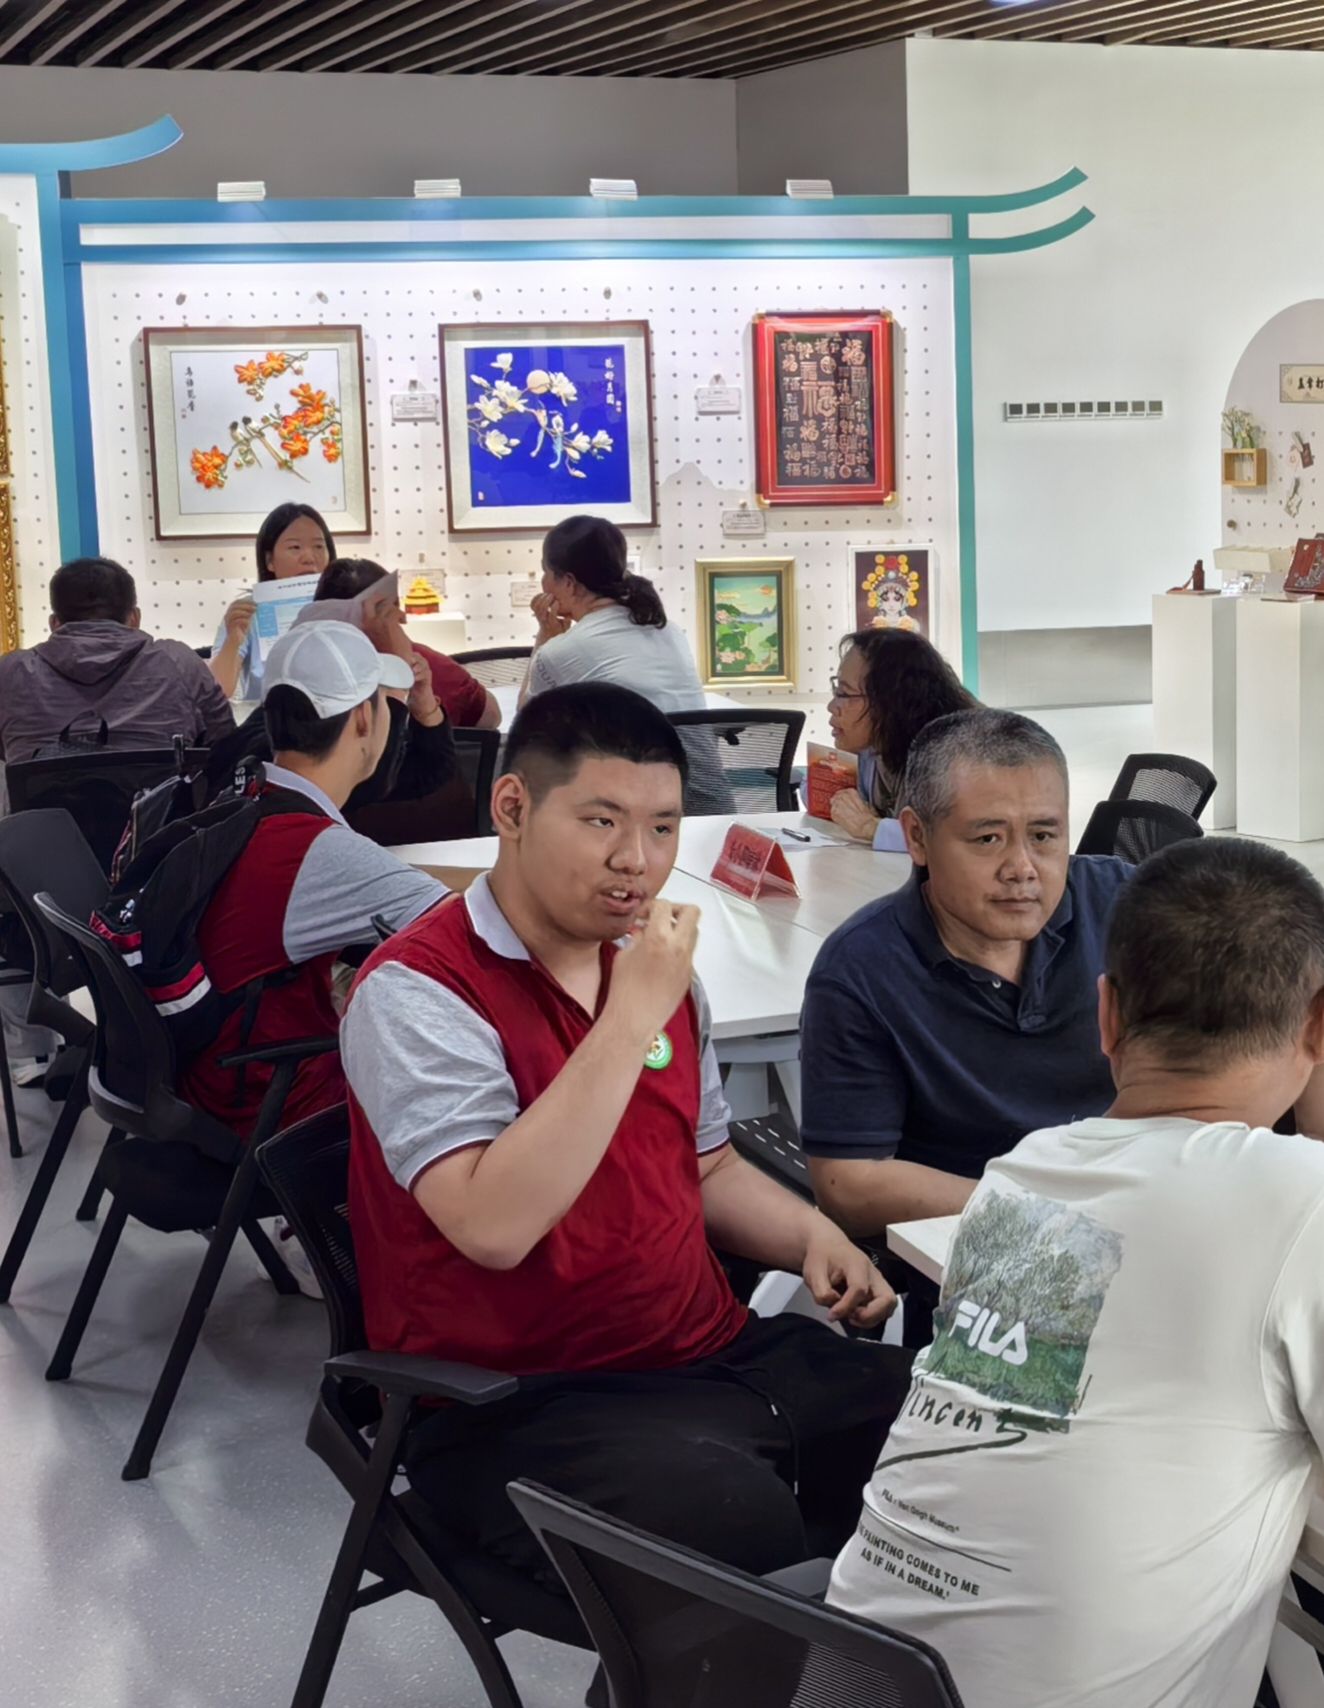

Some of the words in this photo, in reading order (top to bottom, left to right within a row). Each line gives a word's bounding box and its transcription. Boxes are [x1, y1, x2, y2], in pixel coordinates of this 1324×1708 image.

[948, 1300, 1028, 1366] FILA
[860, 1547, 873, 1562] AS
[873, 1554, 884, 1567] IF
[885, 1560, 897, 1575] IN
[897, 1568, 905, 1581] A
[863, 1528, 905, 1561] PAINTING
[906, 1553, 941, 1579] COMES
[943, 1571, 959, 1588] TO
[960, 1579, 981, 1596] ME
